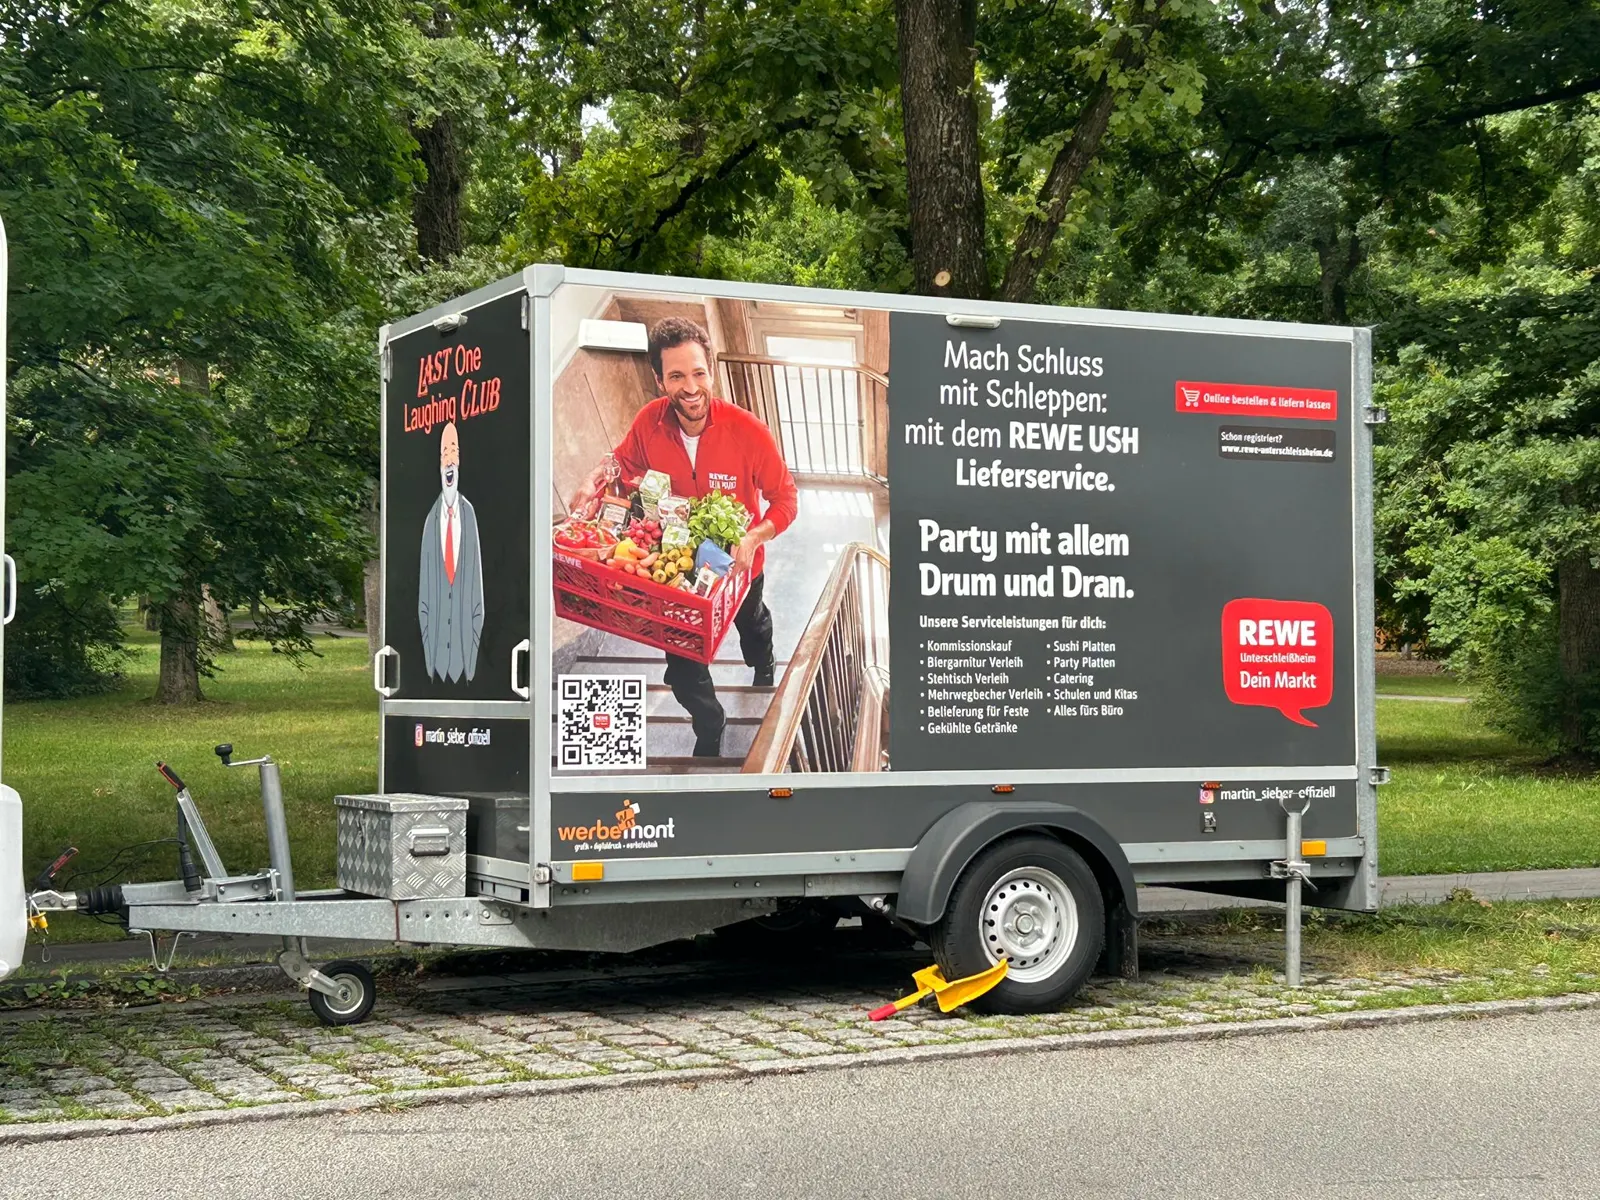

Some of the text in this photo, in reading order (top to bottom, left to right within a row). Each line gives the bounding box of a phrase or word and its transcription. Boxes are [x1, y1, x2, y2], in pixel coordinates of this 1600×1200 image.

[944, 340, 1104, 378] Mach Schluss
[417, 344, 482, 398] LAST One
[404, 377, 502, 434] Laughing CLUB
[940, 378, 1107, 418] mit Schleppen:
[1203, 393, 1331, 410] Online bestellen & liefern lassen
[905, 417, 1139, 454] mit dem REWE USH
[1221, 432, 1283, 444] Schon registriert?
[956, 458, 1116, 492] Lieferservice.
[919, 519, 1130, 562] Party mit allem
[919, 563, 1135, 598] Drum und Dran.
[919, 615, 1107, 631] Unsere Serviceleistungen für dich:
[1239, 619, 1317, 646] REWE
[927, 640, 1013, 652] Kommissionskauf
[1053, 640, 1116, 652] Sushi Platten
[927, 656, 1024, 670] Biergarnitur Verleih
[1053, 656, 1116, 670] Party Platten
[1240, 652, 1316, 664] Unterschleißheim
[927, 673, 1009, 684] Stehtisch Verleih
[1053, 673, 1094, 686] Catering
[1240, 671, 1317, 688] Dein Markt
[928, 688, 1043, 702] Mehrwegbecher Verleih
[1054, 688, 1138, 700] Schulen und Kitas
[927, 705, 1029, 719] Belieferung für Feste
[1054, 704, 1124, 716] Alles fürs Büro
[928, 721, 1018, 734] Gekühlte Getränke
[425, 727, 491, 747] martin_sieber_offiziell
[1220, 785, 1336, 802] martin_sieberoffiziell
[558, 817, 675, 841] werbemont
